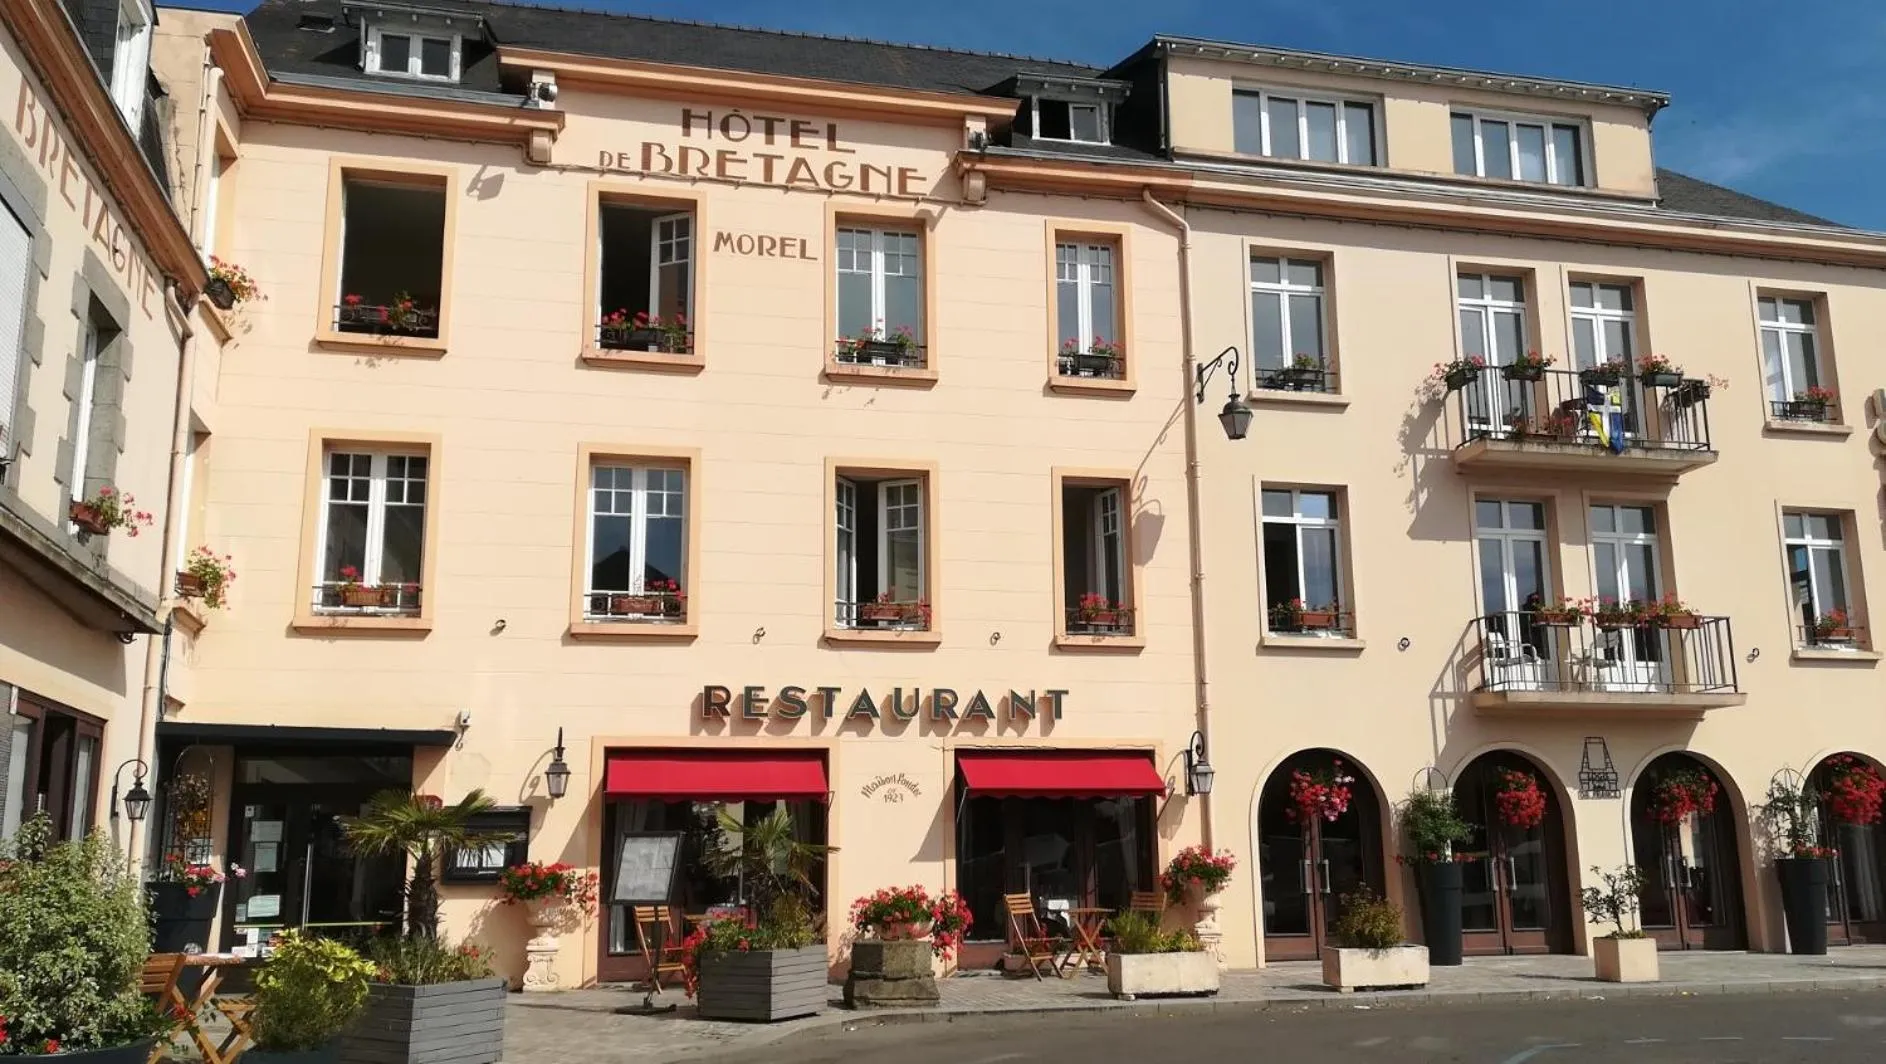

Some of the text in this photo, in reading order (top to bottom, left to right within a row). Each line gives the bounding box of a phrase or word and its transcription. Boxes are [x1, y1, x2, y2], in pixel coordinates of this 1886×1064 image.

[682, 108, 856, 154] HÔTEL
[599, 141, 928, 196] DE BRETAGNE
[16, 73, 156, 320] BRETAGNE
[713, 231, 818, 261] MOREL
[702, 684, 1070, 721] RESTAURANT
